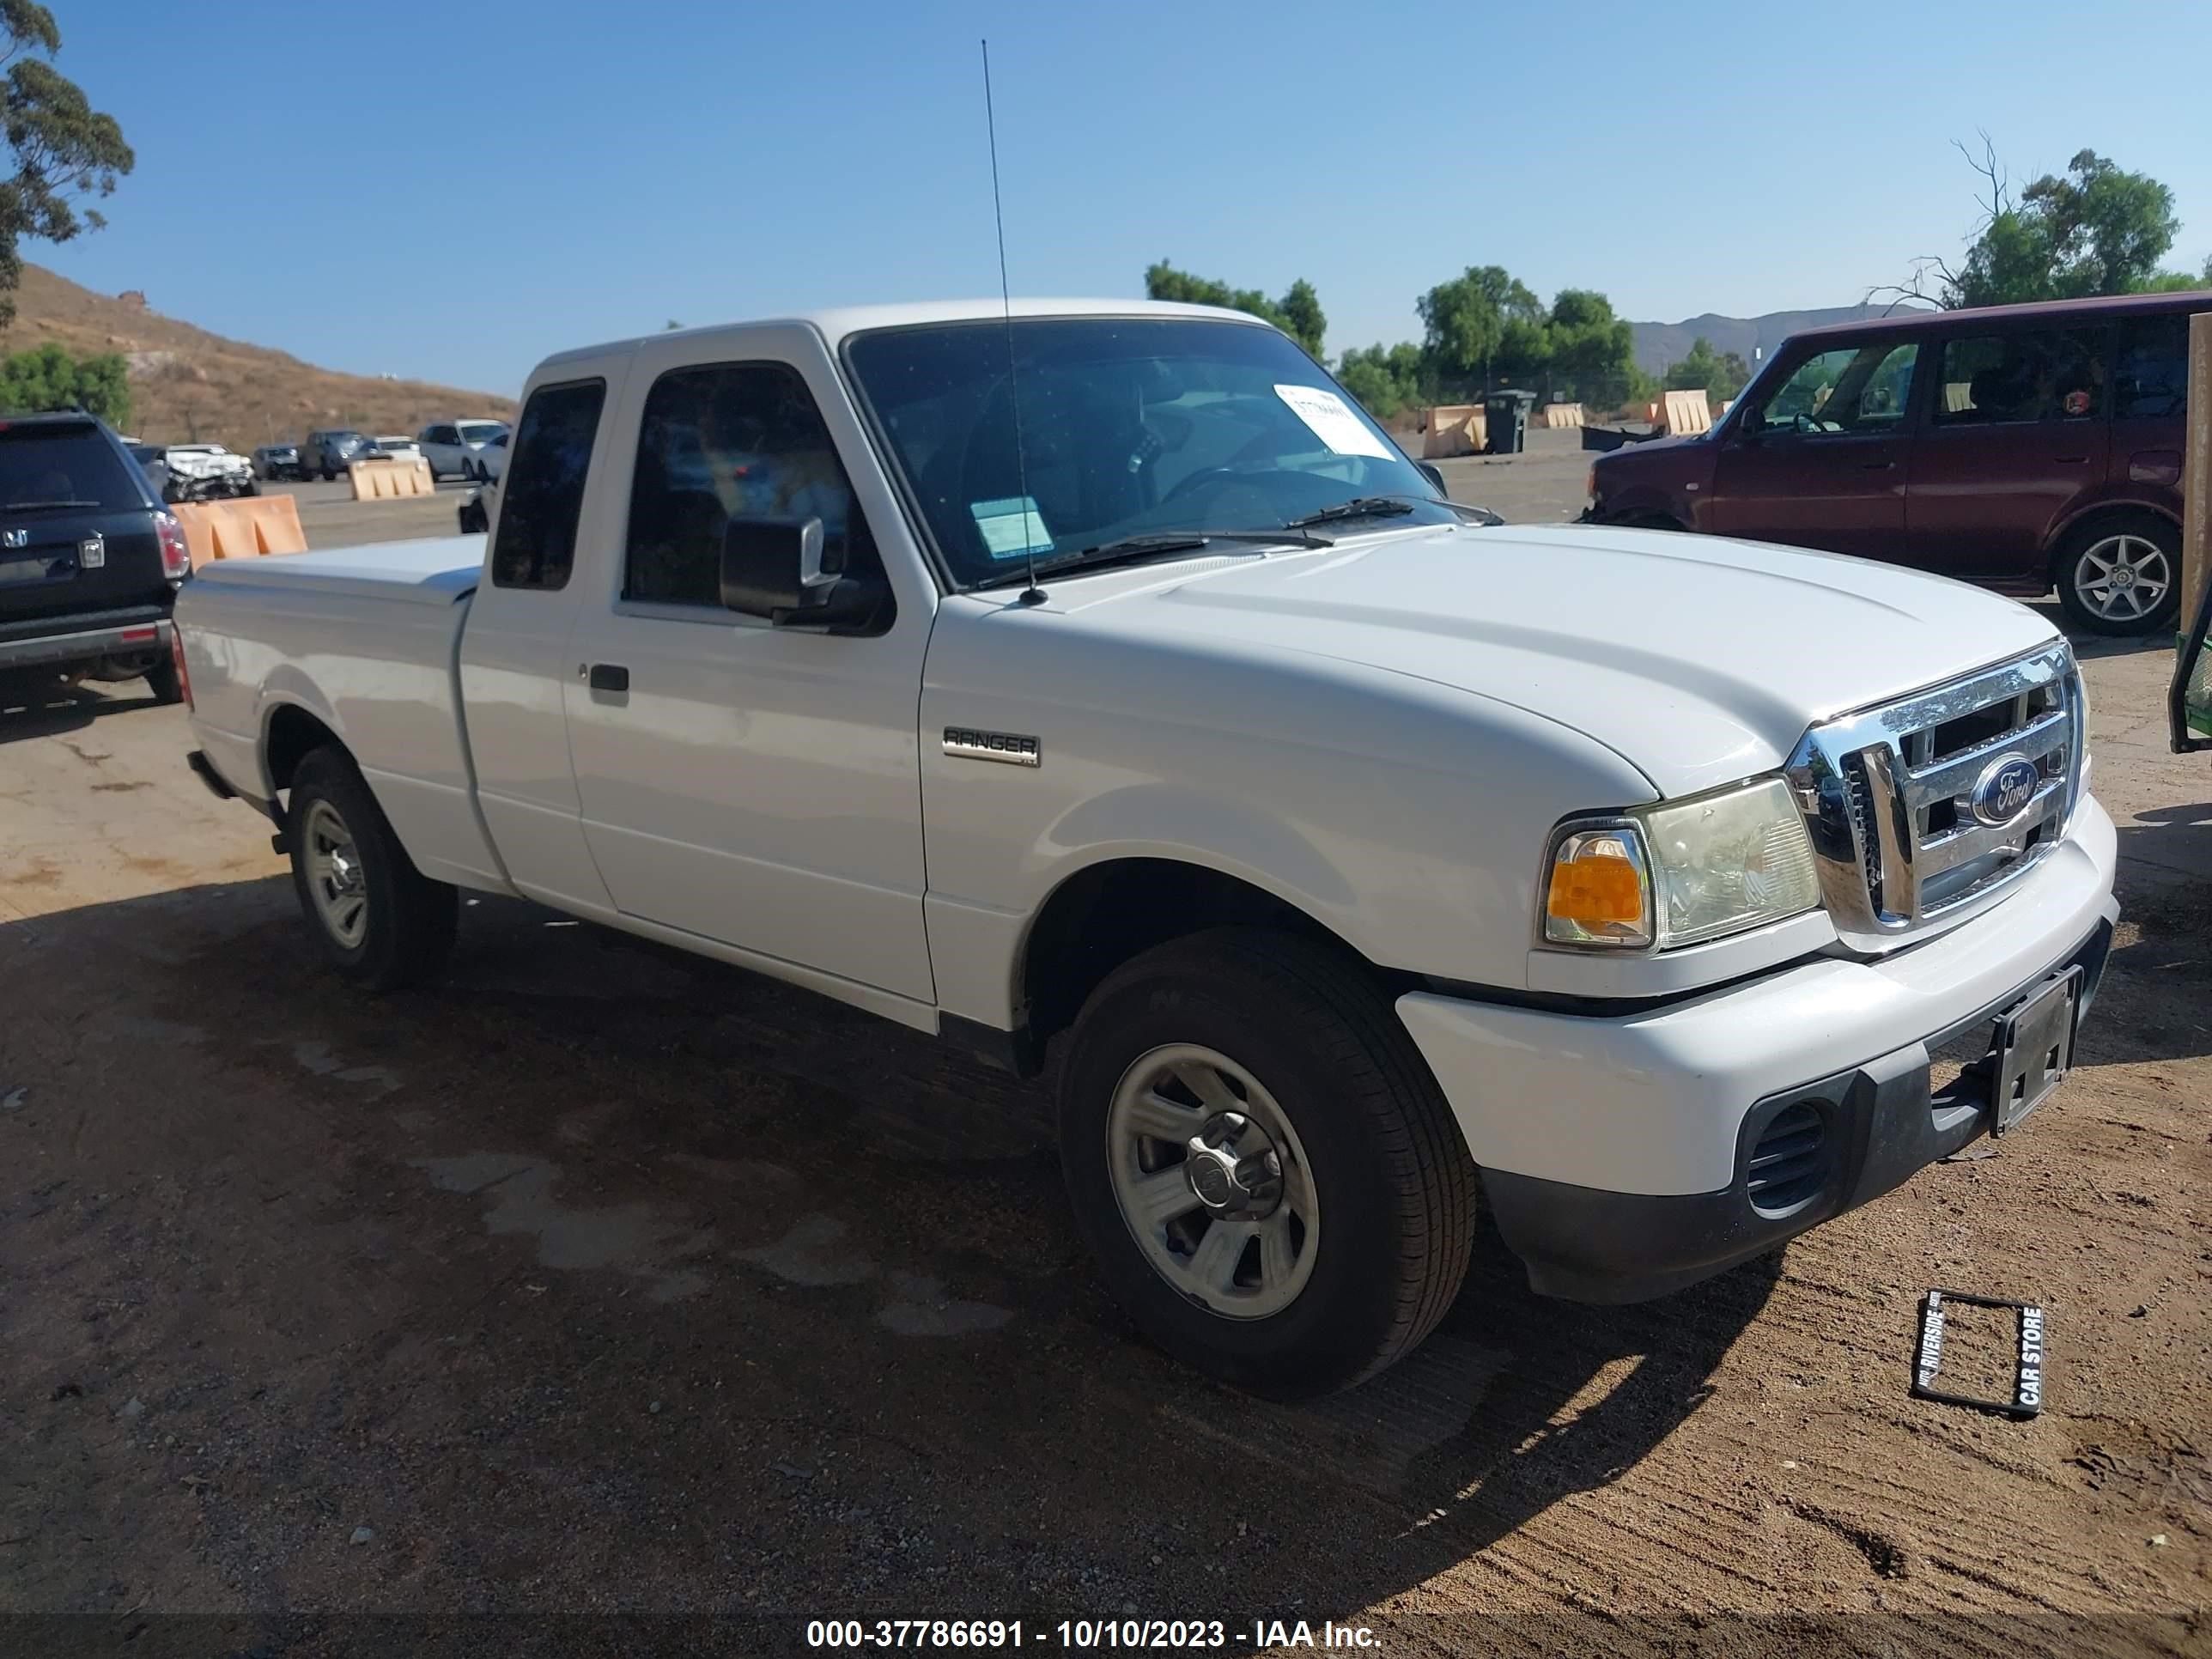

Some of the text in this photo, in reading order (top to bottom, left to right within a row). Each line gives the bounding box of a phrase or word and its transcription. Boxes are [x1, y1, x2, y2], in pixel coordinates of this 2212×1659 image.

[944, 729, 1037, 756] RANGER
[1996, 768, 2031, 811] Ford
[1920, 1310, 1944, 1369] RIVERSIDE
[2019, 1306, 2042, 1406] CAR STORE
[1917, 1370, 1930, 1387] AUTO
